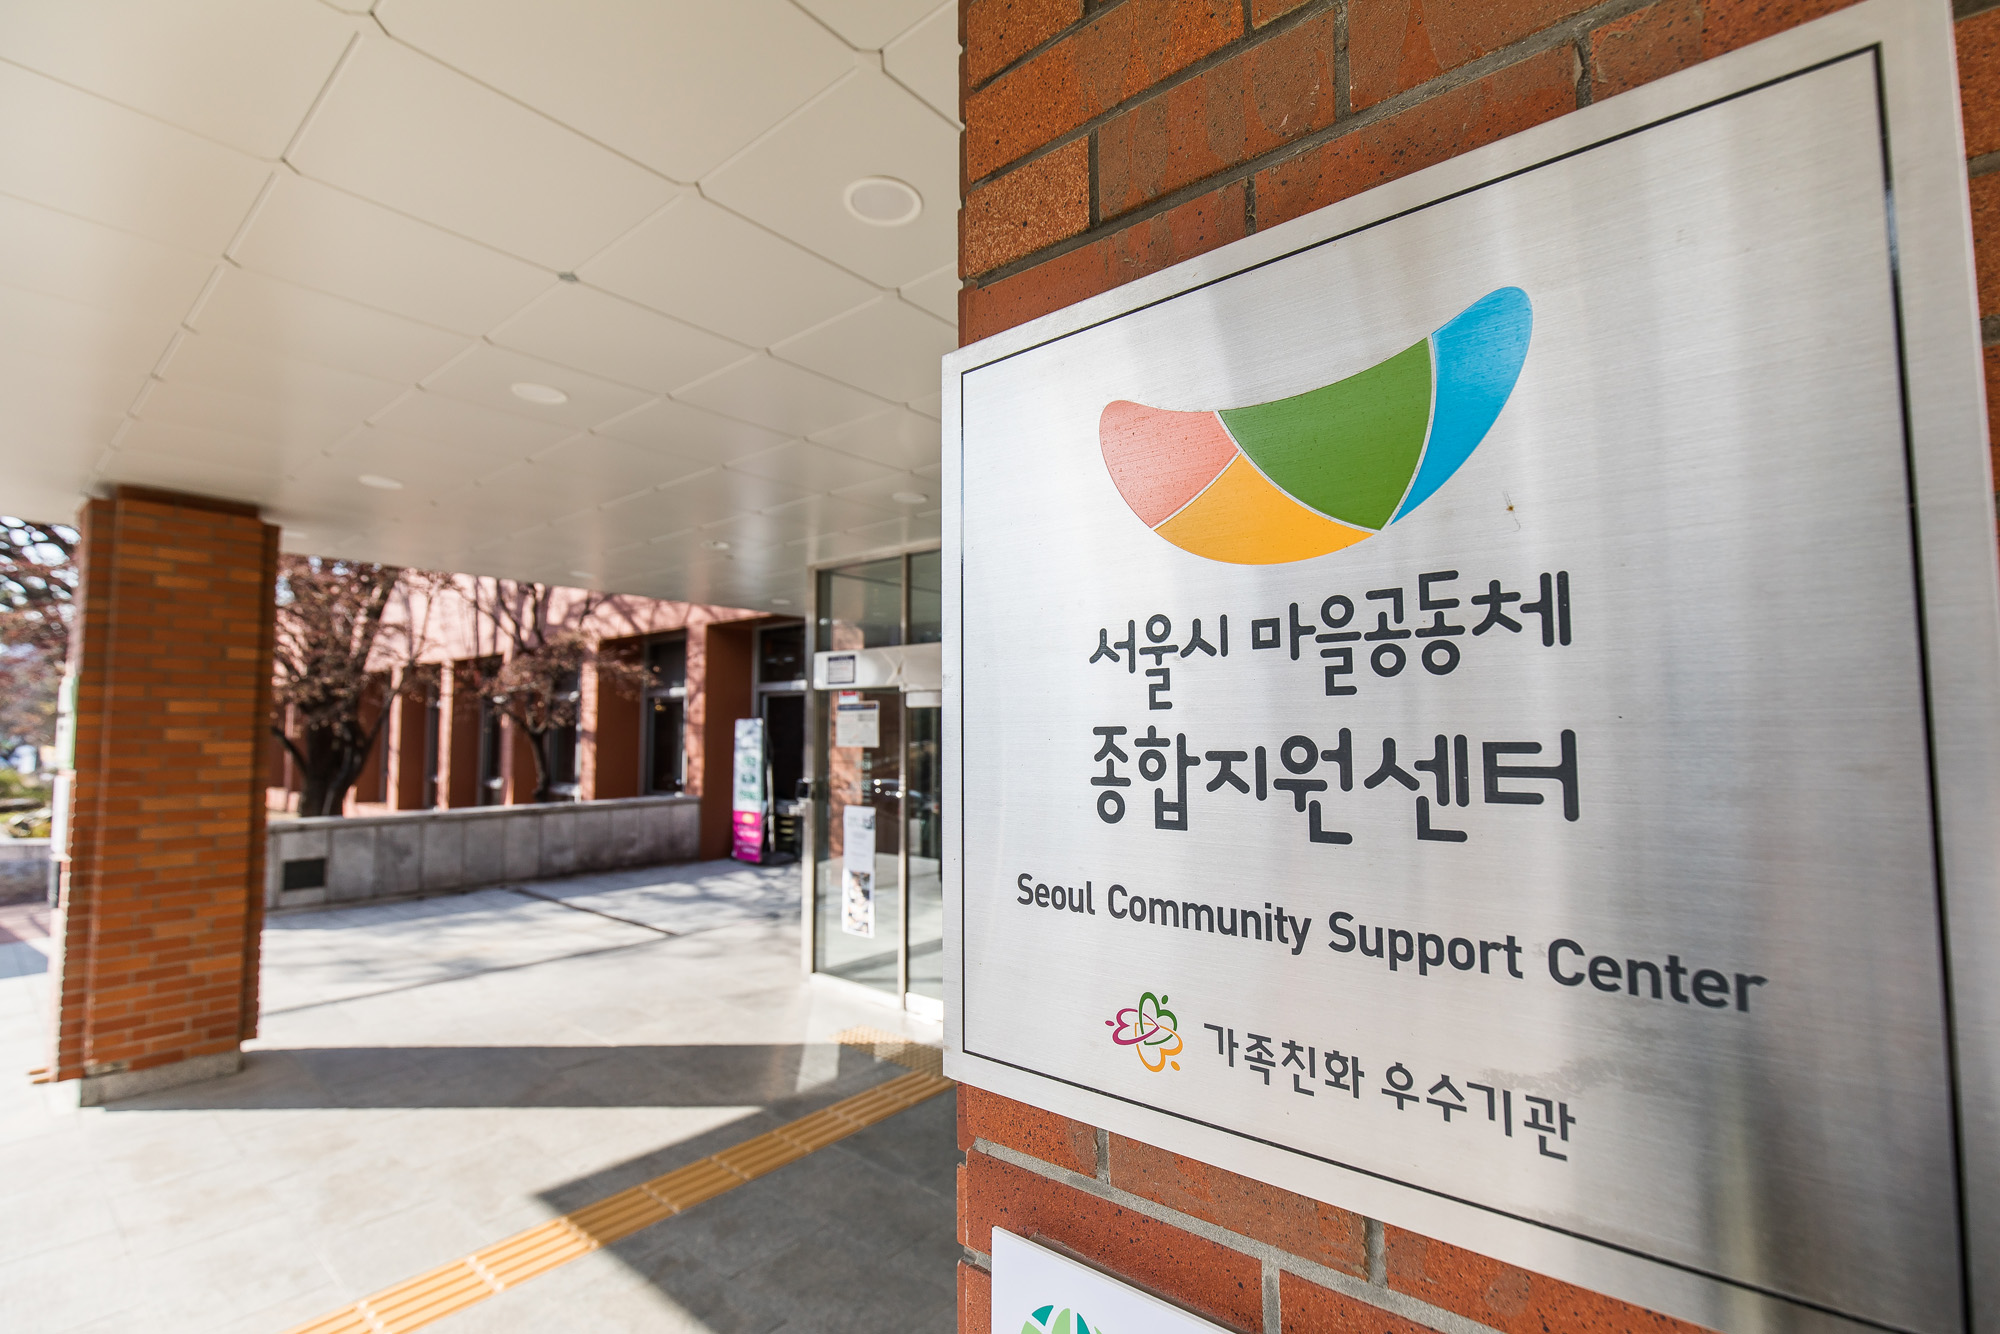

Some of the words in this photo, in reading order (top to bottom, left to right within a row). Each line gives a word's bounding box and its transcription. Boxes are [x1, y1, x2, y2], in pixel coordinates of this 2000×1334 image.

[1089, 614, 1229, 710] 서울시
[1252, 570, 1572, 696] 마을공동체
[1091, 725, 1580, 845] 종합지원센터
[1016, 873, 1096, 916] Seoul
[1107, 885, 1313, 955] Community
[1328, 912, 1524, 979] Support
[1547, 939, 1768, 1012] Center
[1203, 1023, 1365, 1099] 가족친화
[1382, 1062, 1577, 1161] 우수기관
